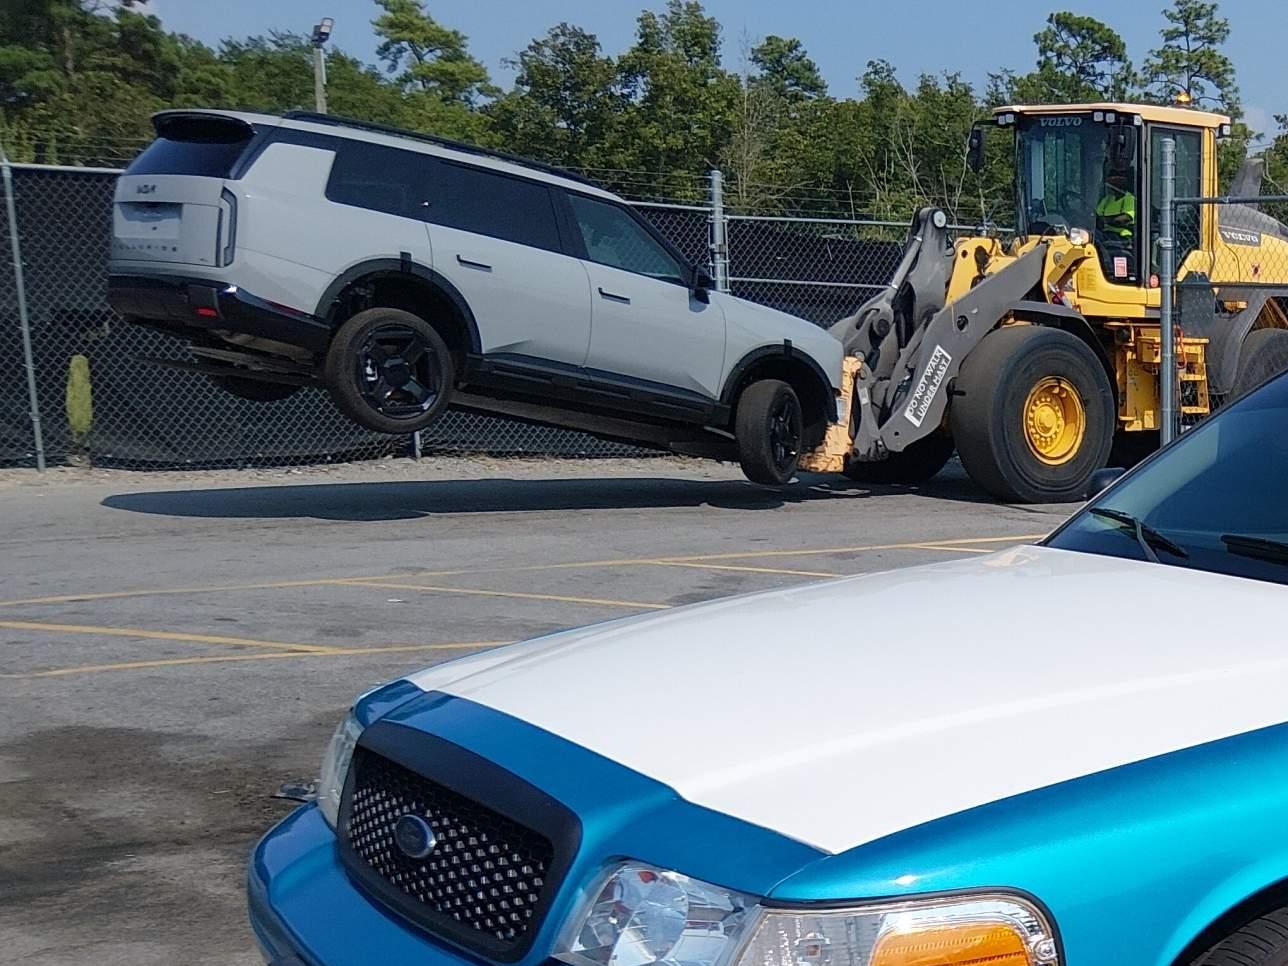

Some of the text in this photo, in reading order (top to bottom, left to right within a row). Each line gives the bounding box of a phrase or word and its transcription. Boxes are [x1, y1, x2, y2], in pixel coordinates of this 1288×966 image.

[1040, 117, 1082, 127] VOLVO
[1222, 231, 1259, 242] VOLVO
[907, 350, 942, 415] DO NOT WALK
[917, 358, 948, 417] UNDER MAST
